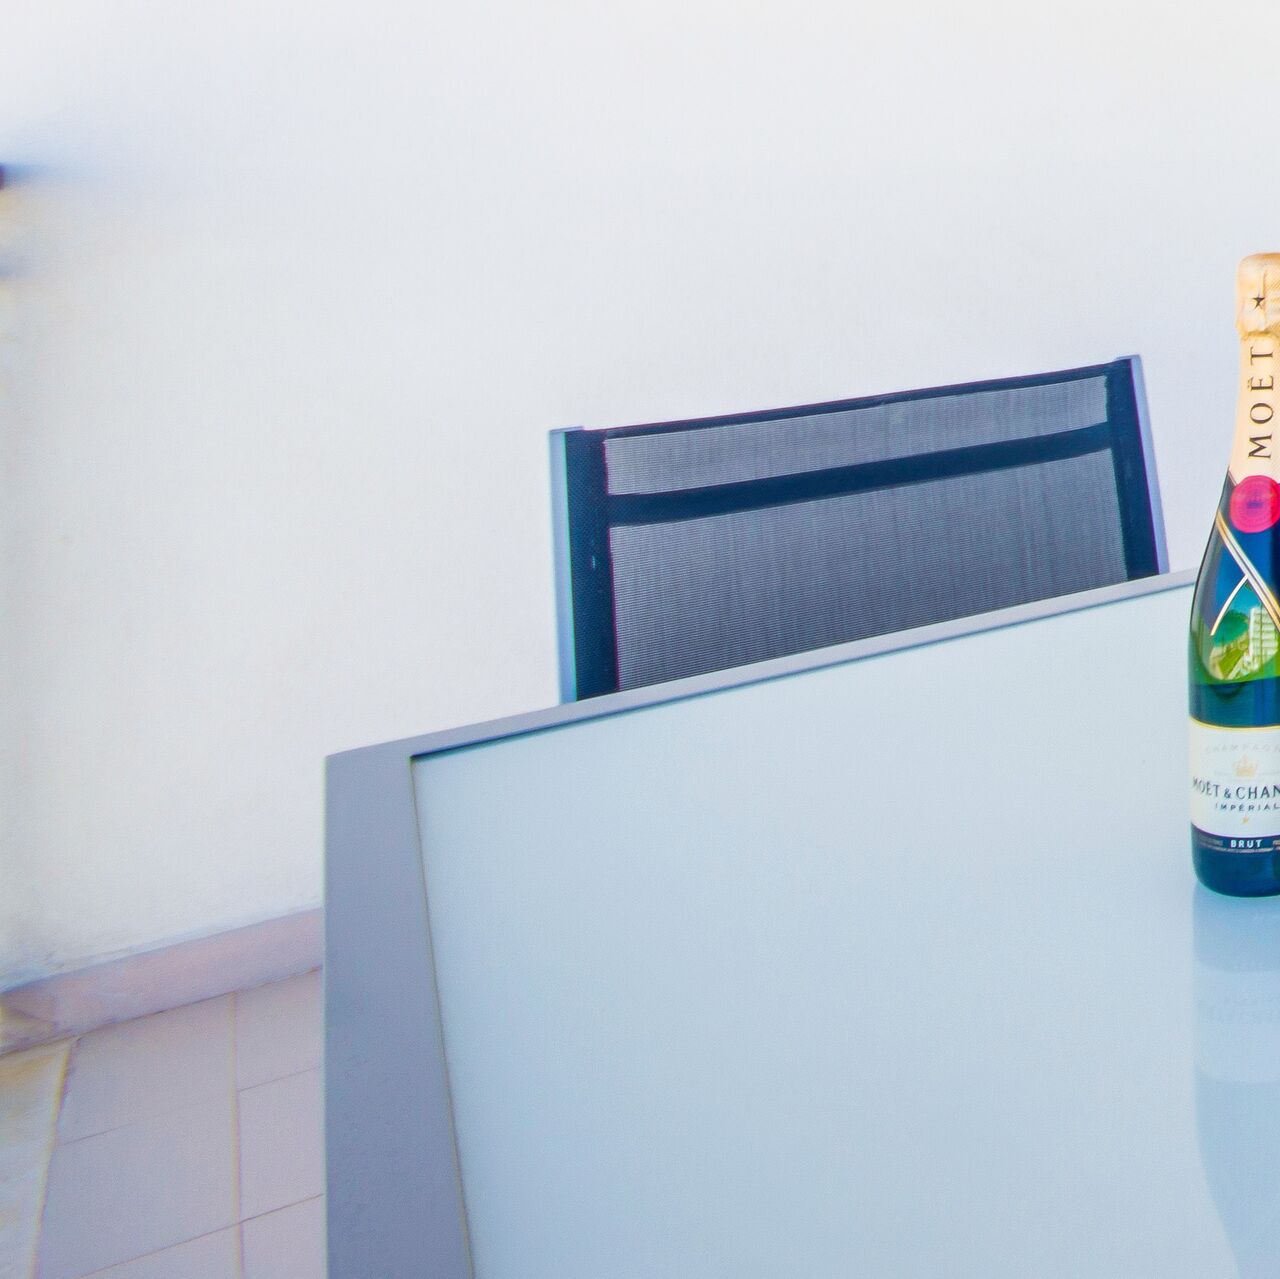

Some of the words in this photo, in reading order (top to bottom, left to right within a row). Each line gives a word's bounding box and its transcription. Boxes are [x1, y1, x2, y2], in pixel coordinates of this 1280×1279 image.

[1247, 346, 1275, 459] MOËT
[1224, 788, 1232, 799] &
[1230, 839, 1262, 848] BRUT
